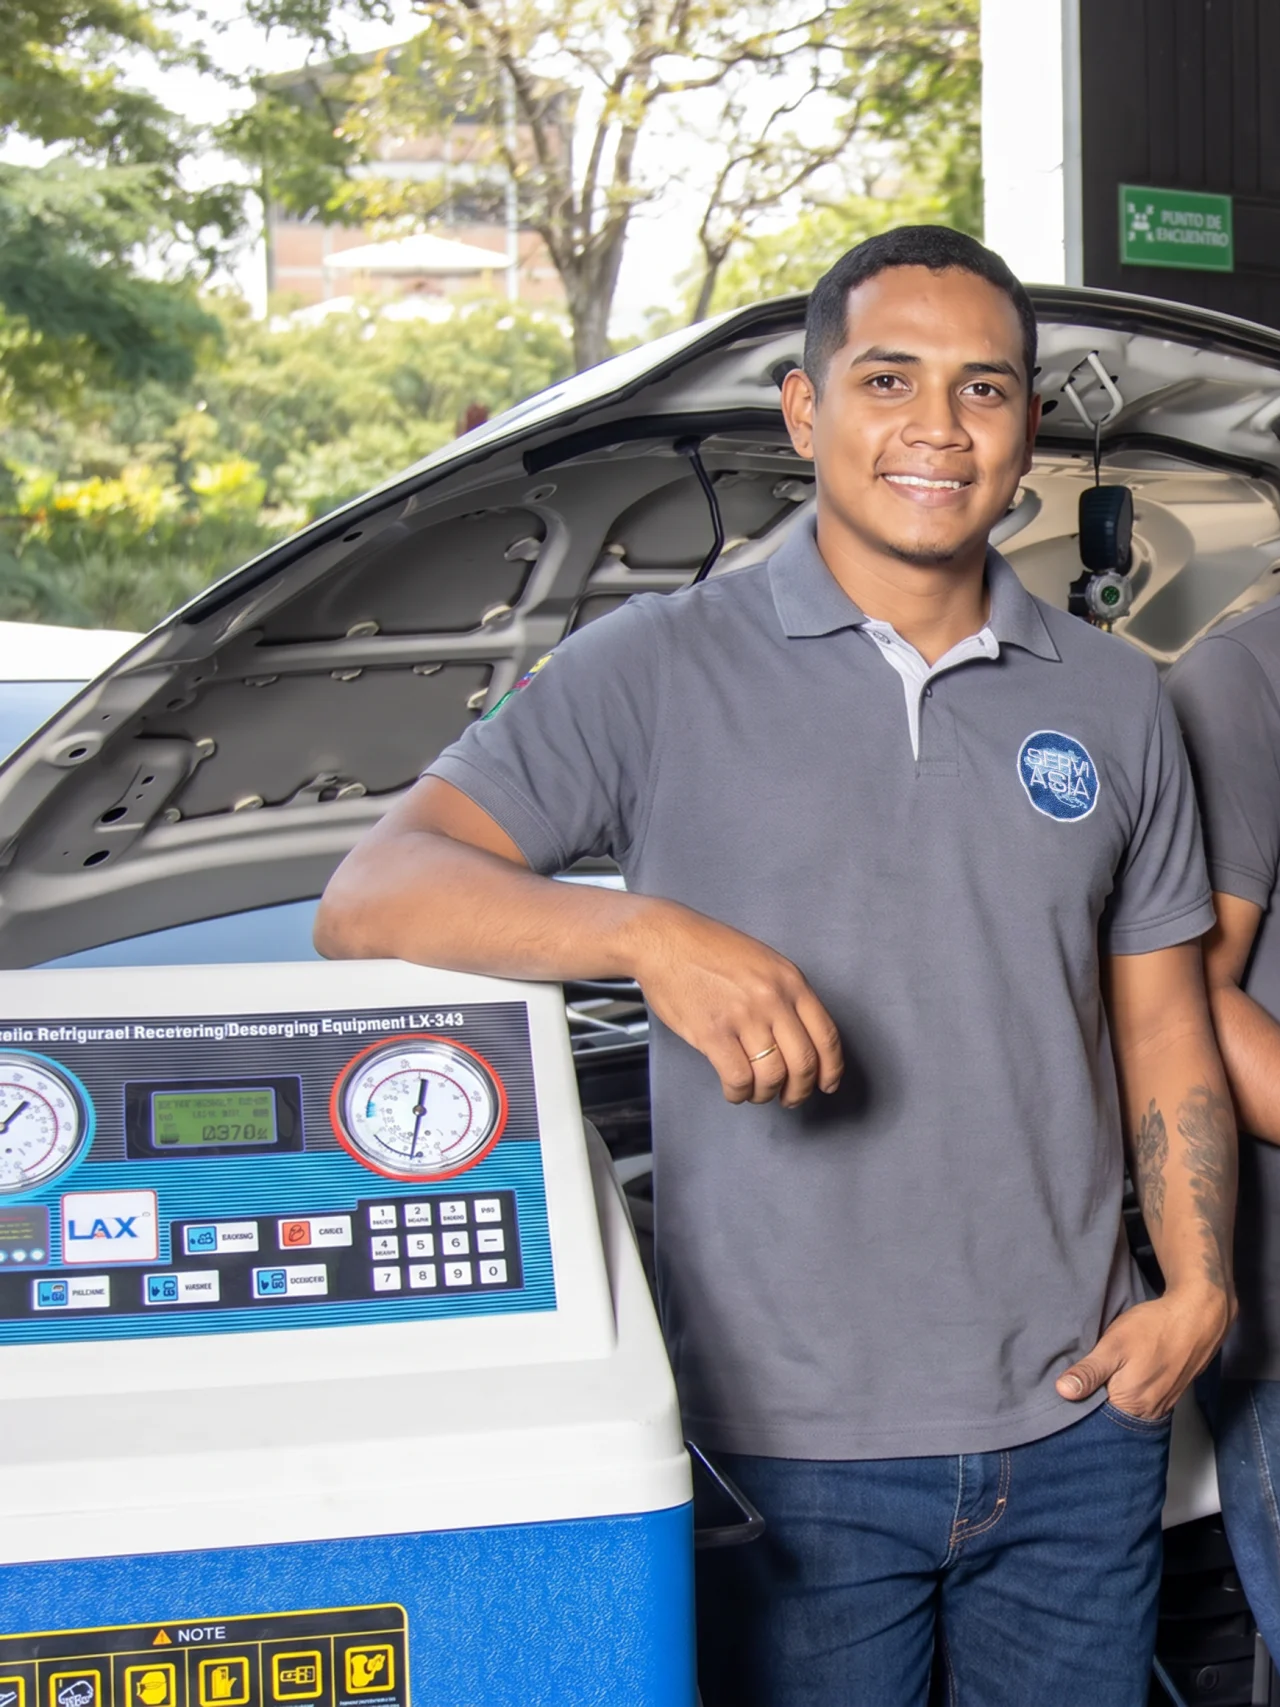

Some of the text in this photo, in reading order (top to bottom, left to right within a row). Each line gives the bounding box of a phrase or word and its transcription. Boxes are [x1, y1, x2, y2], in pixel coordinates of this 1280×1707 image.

[1161, 210, 1223, 230] PUNTO DE
[1156, 227, 1230, 247] ENCUENTRO
[1030, 765, 1090, 800] ASIA
[321, 1015, 405, 1034] Equipment
[409, 1012, 465, 1029] LX-343
[414, 1206, 421, 1215] 2
[68, 1216, 140, 1240] LAX
[381, 1240, 388, 1248] 4
[416, 1240, 425, 1250] 5
[451, 1238, 460, 1248] 6
[418, 1271, 427, 1281] 8
[453, 1268, 463, 1279] 9
[489, 1266, 498, 1276] 0
[384, 1273, 391, 1283] 7
[178, 1626, 226, 1642] NOTE
